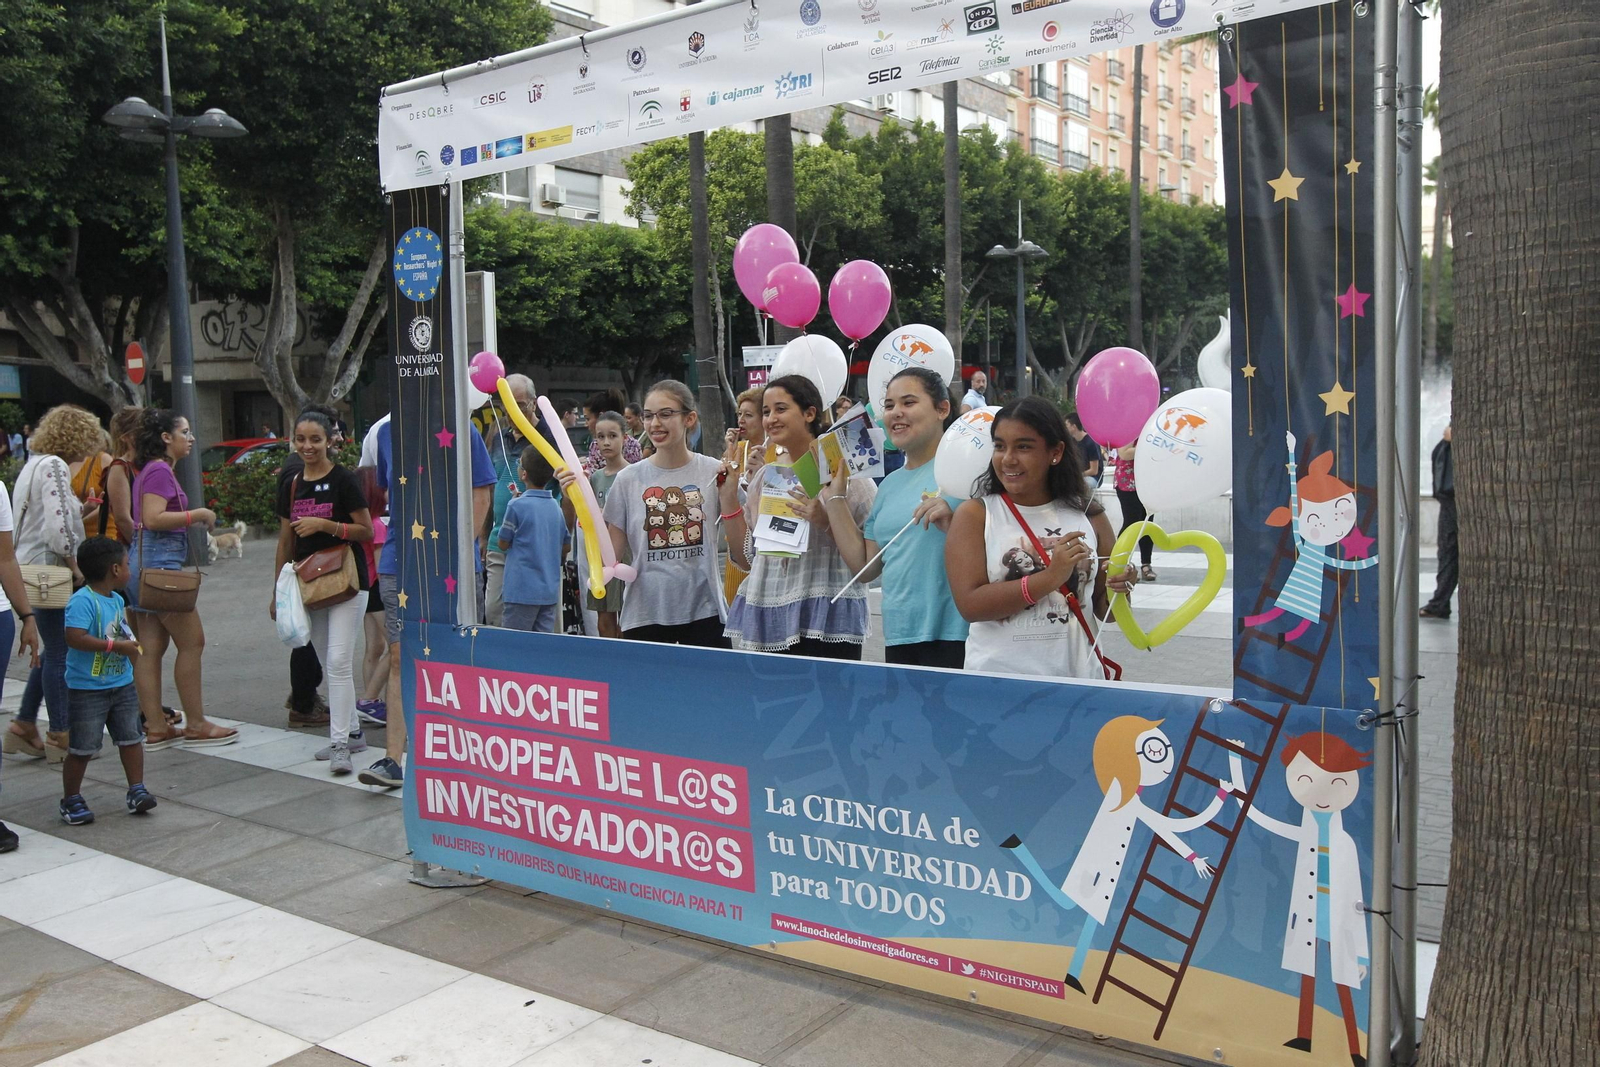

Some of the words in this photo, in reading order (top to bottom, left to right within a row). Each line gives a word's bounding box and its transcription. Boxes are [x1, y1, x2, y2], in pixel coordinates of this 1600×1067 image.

[970, 8, 992, 19] ONDA
[973, 19, 993, 29] CERO
[1090, 26, 1114, 36] Ciencia
[1154, 28, 1169, 36] Calar
[1090, 31, 1118, 43] Divertida
[827, 40, 859, 52] Colaboran
[867, 66, 902, 85] SER
[480, 90, 507, 106] CSIC
[633, 87, 660, 97] Patrocinan
[722, 85, 765, 101] cajamar
[576, 125, 596, 137] FECYT
[399, 367, 412, 377] DE
[750, 372, 762, 381] LA
[647, 546, 705, 562] H.POTTER
[421, 668, 461, 710] LA
[478, 676, 599, 731] NOCHE
[424, 722, 581, 786] EUROPEA
[594, 751, 643, 798] DE
[652, 761, 738, 816] L@S
[764, 787, 797, 817] La
[802, 794, 937, 842] CIENCIA
[943, 816, 980, 848] de
[424, 777, 743, 879] INVESTIGADOR@S
[767, 830, 796, 857] tu
[800, 833, 1032, 902] UNIVERSIDAD
[432, 833, 486, 858] MUJERES
[488, 846, 495, 857] Y
[497, 847, 555, 875] HOMBRES
[557, 864, 582, 882] QUE
[583, 871, 627, 894] HACEN
[630, 881, 685, 908] CIENCIA
[689, 895, 726, 918] PARA
[729, 903, 743, 921] TI
[770, 870, 831, 900] para
[835, 876, 946, 926] TODOS
[776, 918, 939, 967] www.lanochedelosinvestigadores.es
[979, 967, 1059, 995] #NIGHTSPAIN
